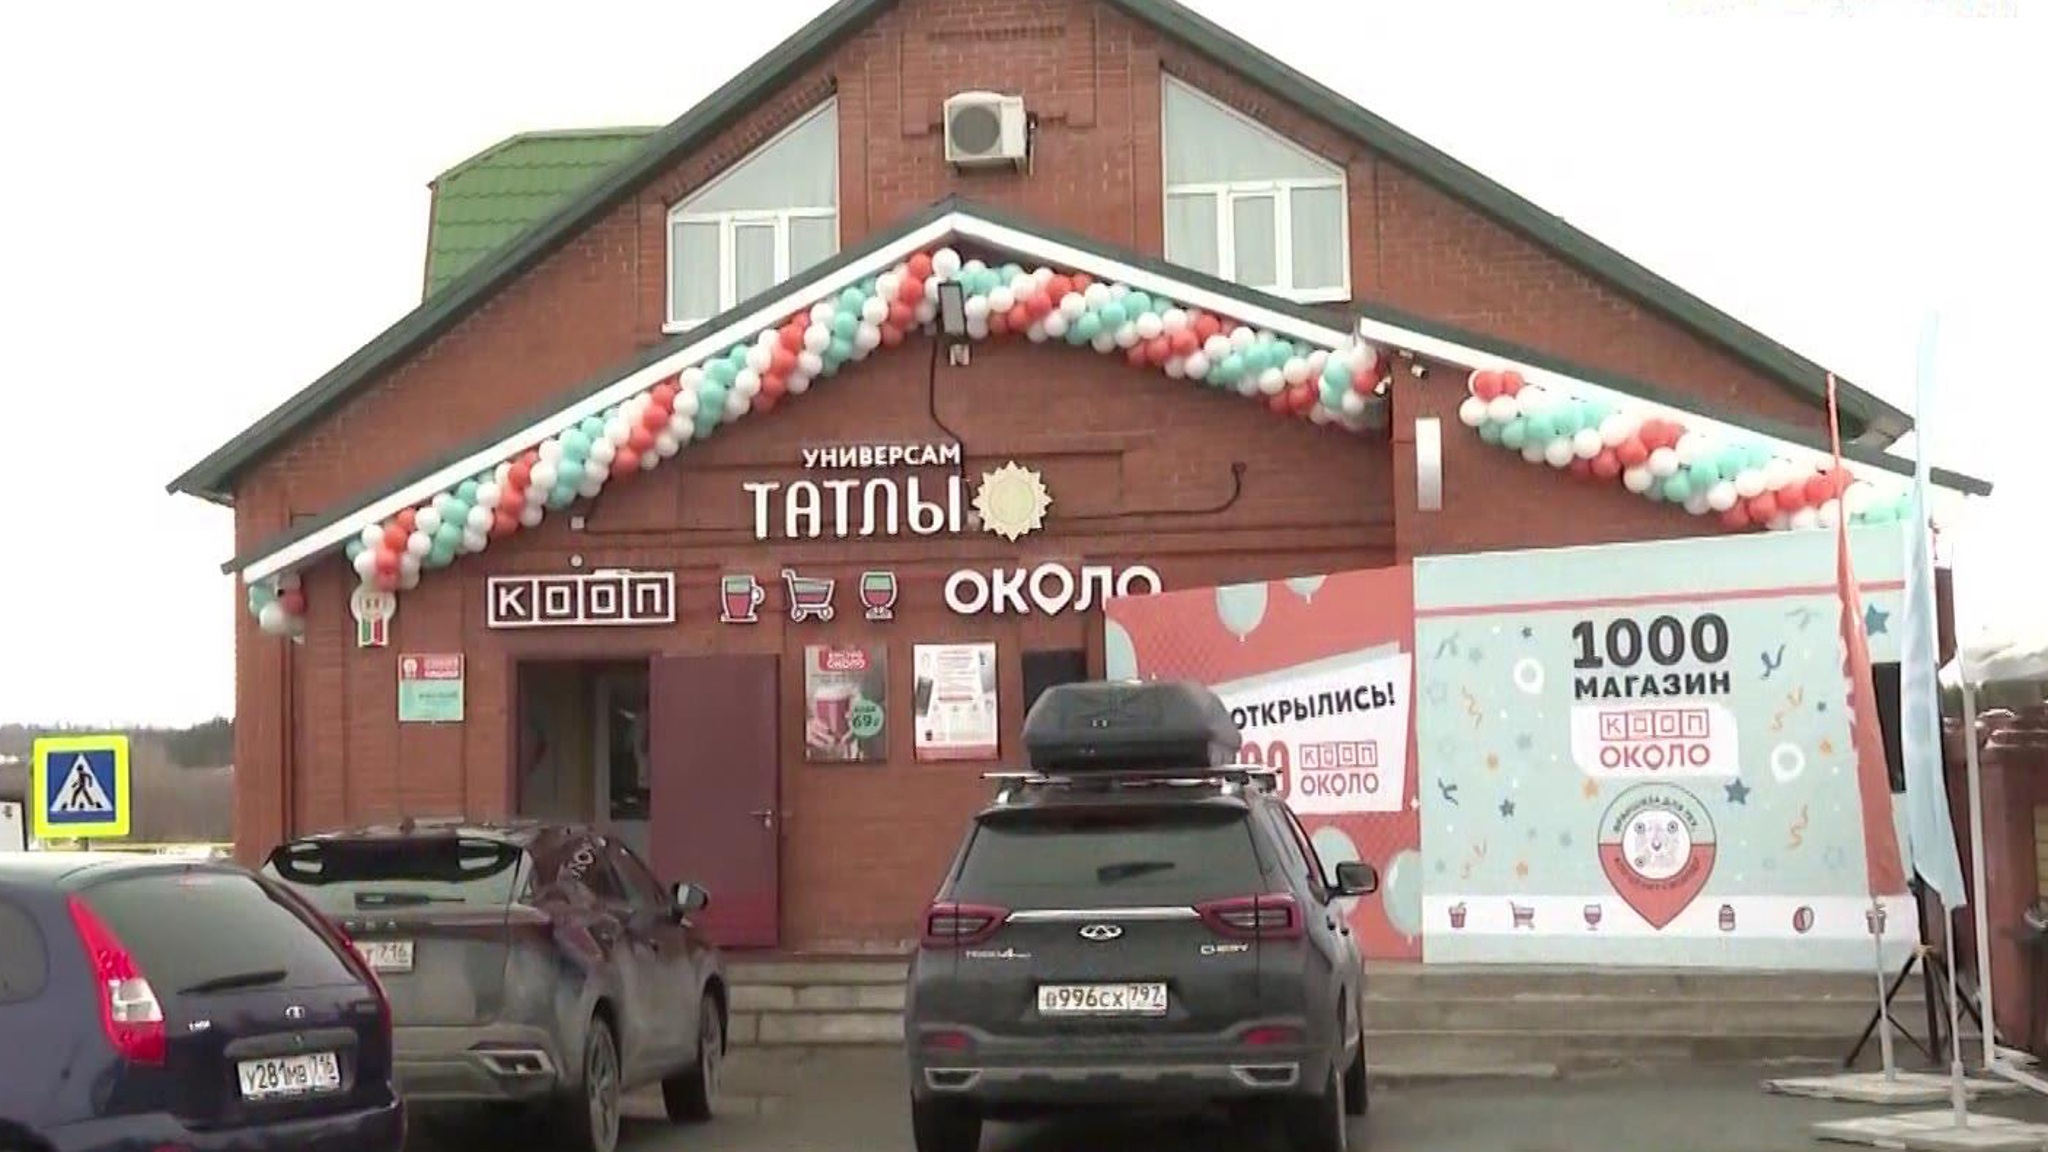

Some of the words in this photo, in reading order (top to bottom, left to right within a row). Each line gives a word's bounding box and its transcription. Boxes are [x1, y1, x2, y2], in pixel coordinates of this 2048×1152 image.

[803, 443, 961, 468] УНИВЕРСАМ
[743, 475, 961, 539] ТАТЛЫ
[493, 577, 669, 622] КООП
[944, 563, 1162, 616] ОКОЛО
[1572, 613, 1729, 668] 1000
[1575, 670, 1731, 700] МАГАЗИН
[1230, 681, 1395, 730] ОТКРЫЛИСЬ!
[1602, 711, 1706, 738] КООП
[1302, 743, 1375, 767] КООП
[1600, 744, 1710, 770] ОКОЛО
[1300, 772, 1379, 797] ОКОЛО
[1130, 985, 1162, 1001] 797
